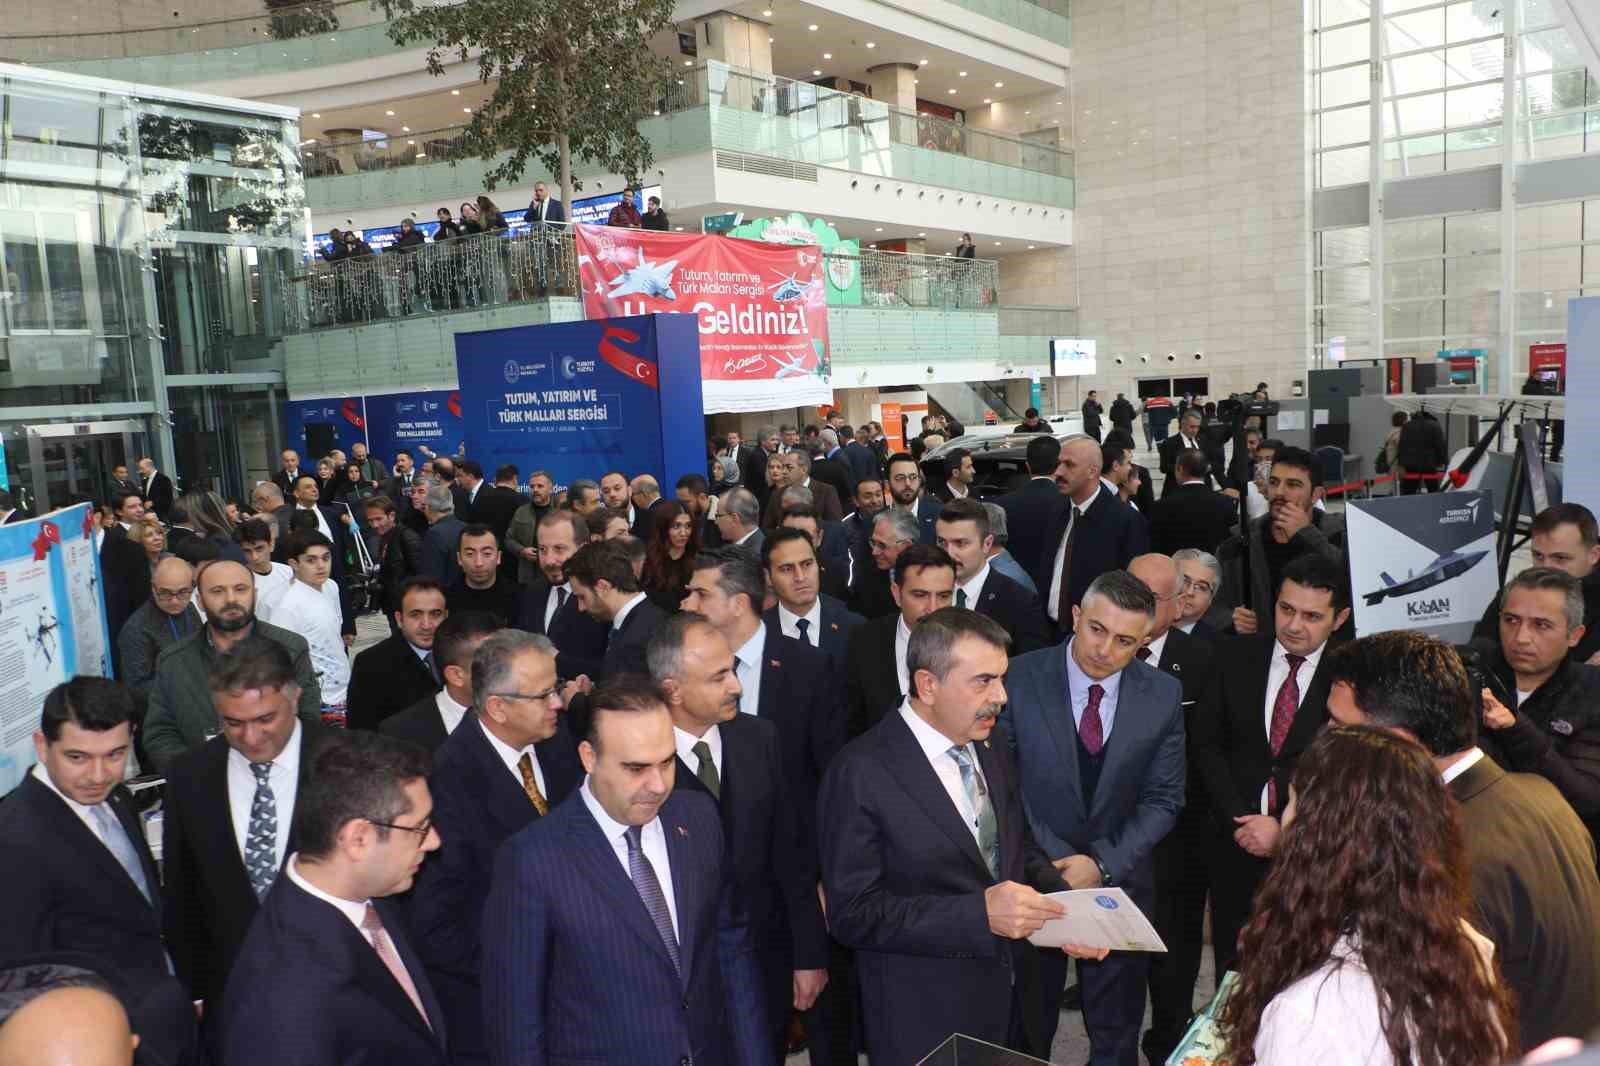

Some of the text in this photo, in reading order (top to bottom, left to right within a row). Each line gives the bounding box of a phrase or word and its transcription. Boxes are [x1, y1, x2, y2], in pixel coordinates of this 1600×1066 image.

[679, 268, 712, 281] Tutum,
[677, 281, 765, 299] Türk Malları Sergisi
[693, 301, 809, 335] Geldiniz!
[504, 388, 598, 406] TUTUM, YATIRIM VE
[498, 404, 608, 423] TÜRK MALLARI SERGİSİ
[1407, 598, 1450, 616] KAAN
